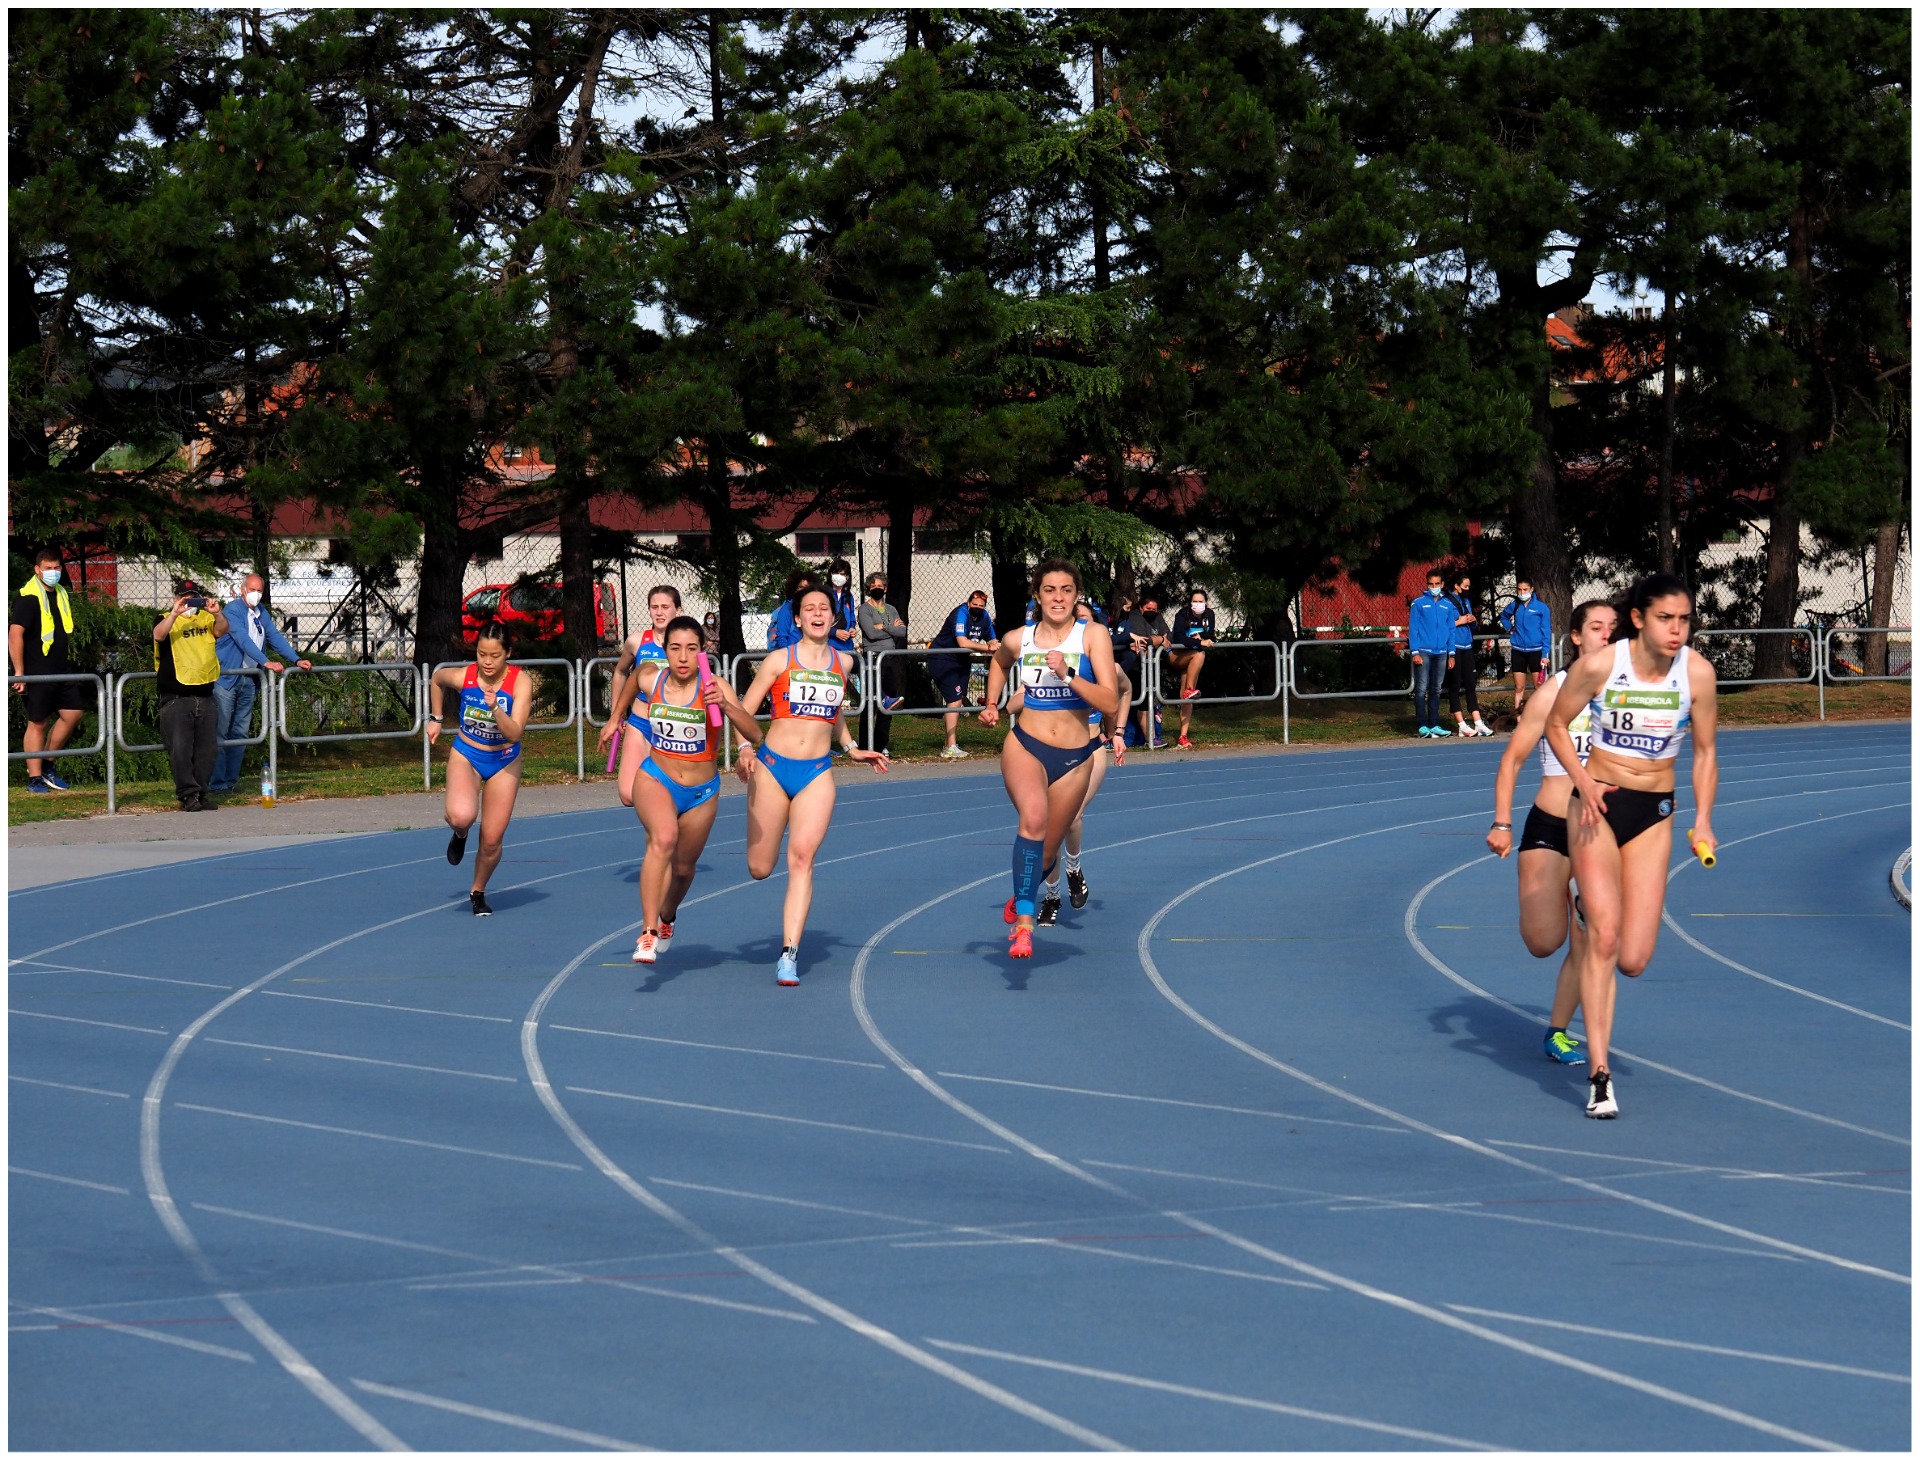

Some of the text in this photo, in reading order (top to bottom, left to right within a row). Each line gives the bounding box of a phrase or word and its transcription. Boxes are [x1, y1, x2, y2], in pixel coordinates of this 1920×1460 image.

[808, 674, 839, 683] IBERDROLA
[1034, 668, 1043, 684] 7
[800, 685, 817, 701] 12
[1626, 696, 1673, 706] IBERDROLA
[666, 710, 700, 721] IBERDROLA
[1610, 711, 1634, 731] 18
[468, 726, 503, 739] Joma
[657, 721, 674, 738] 12
[656, 737, 698, 752] Joma
[1608, 734, 1664, 752] Joma
[1019, 848, 1038, 896] Kalenji
